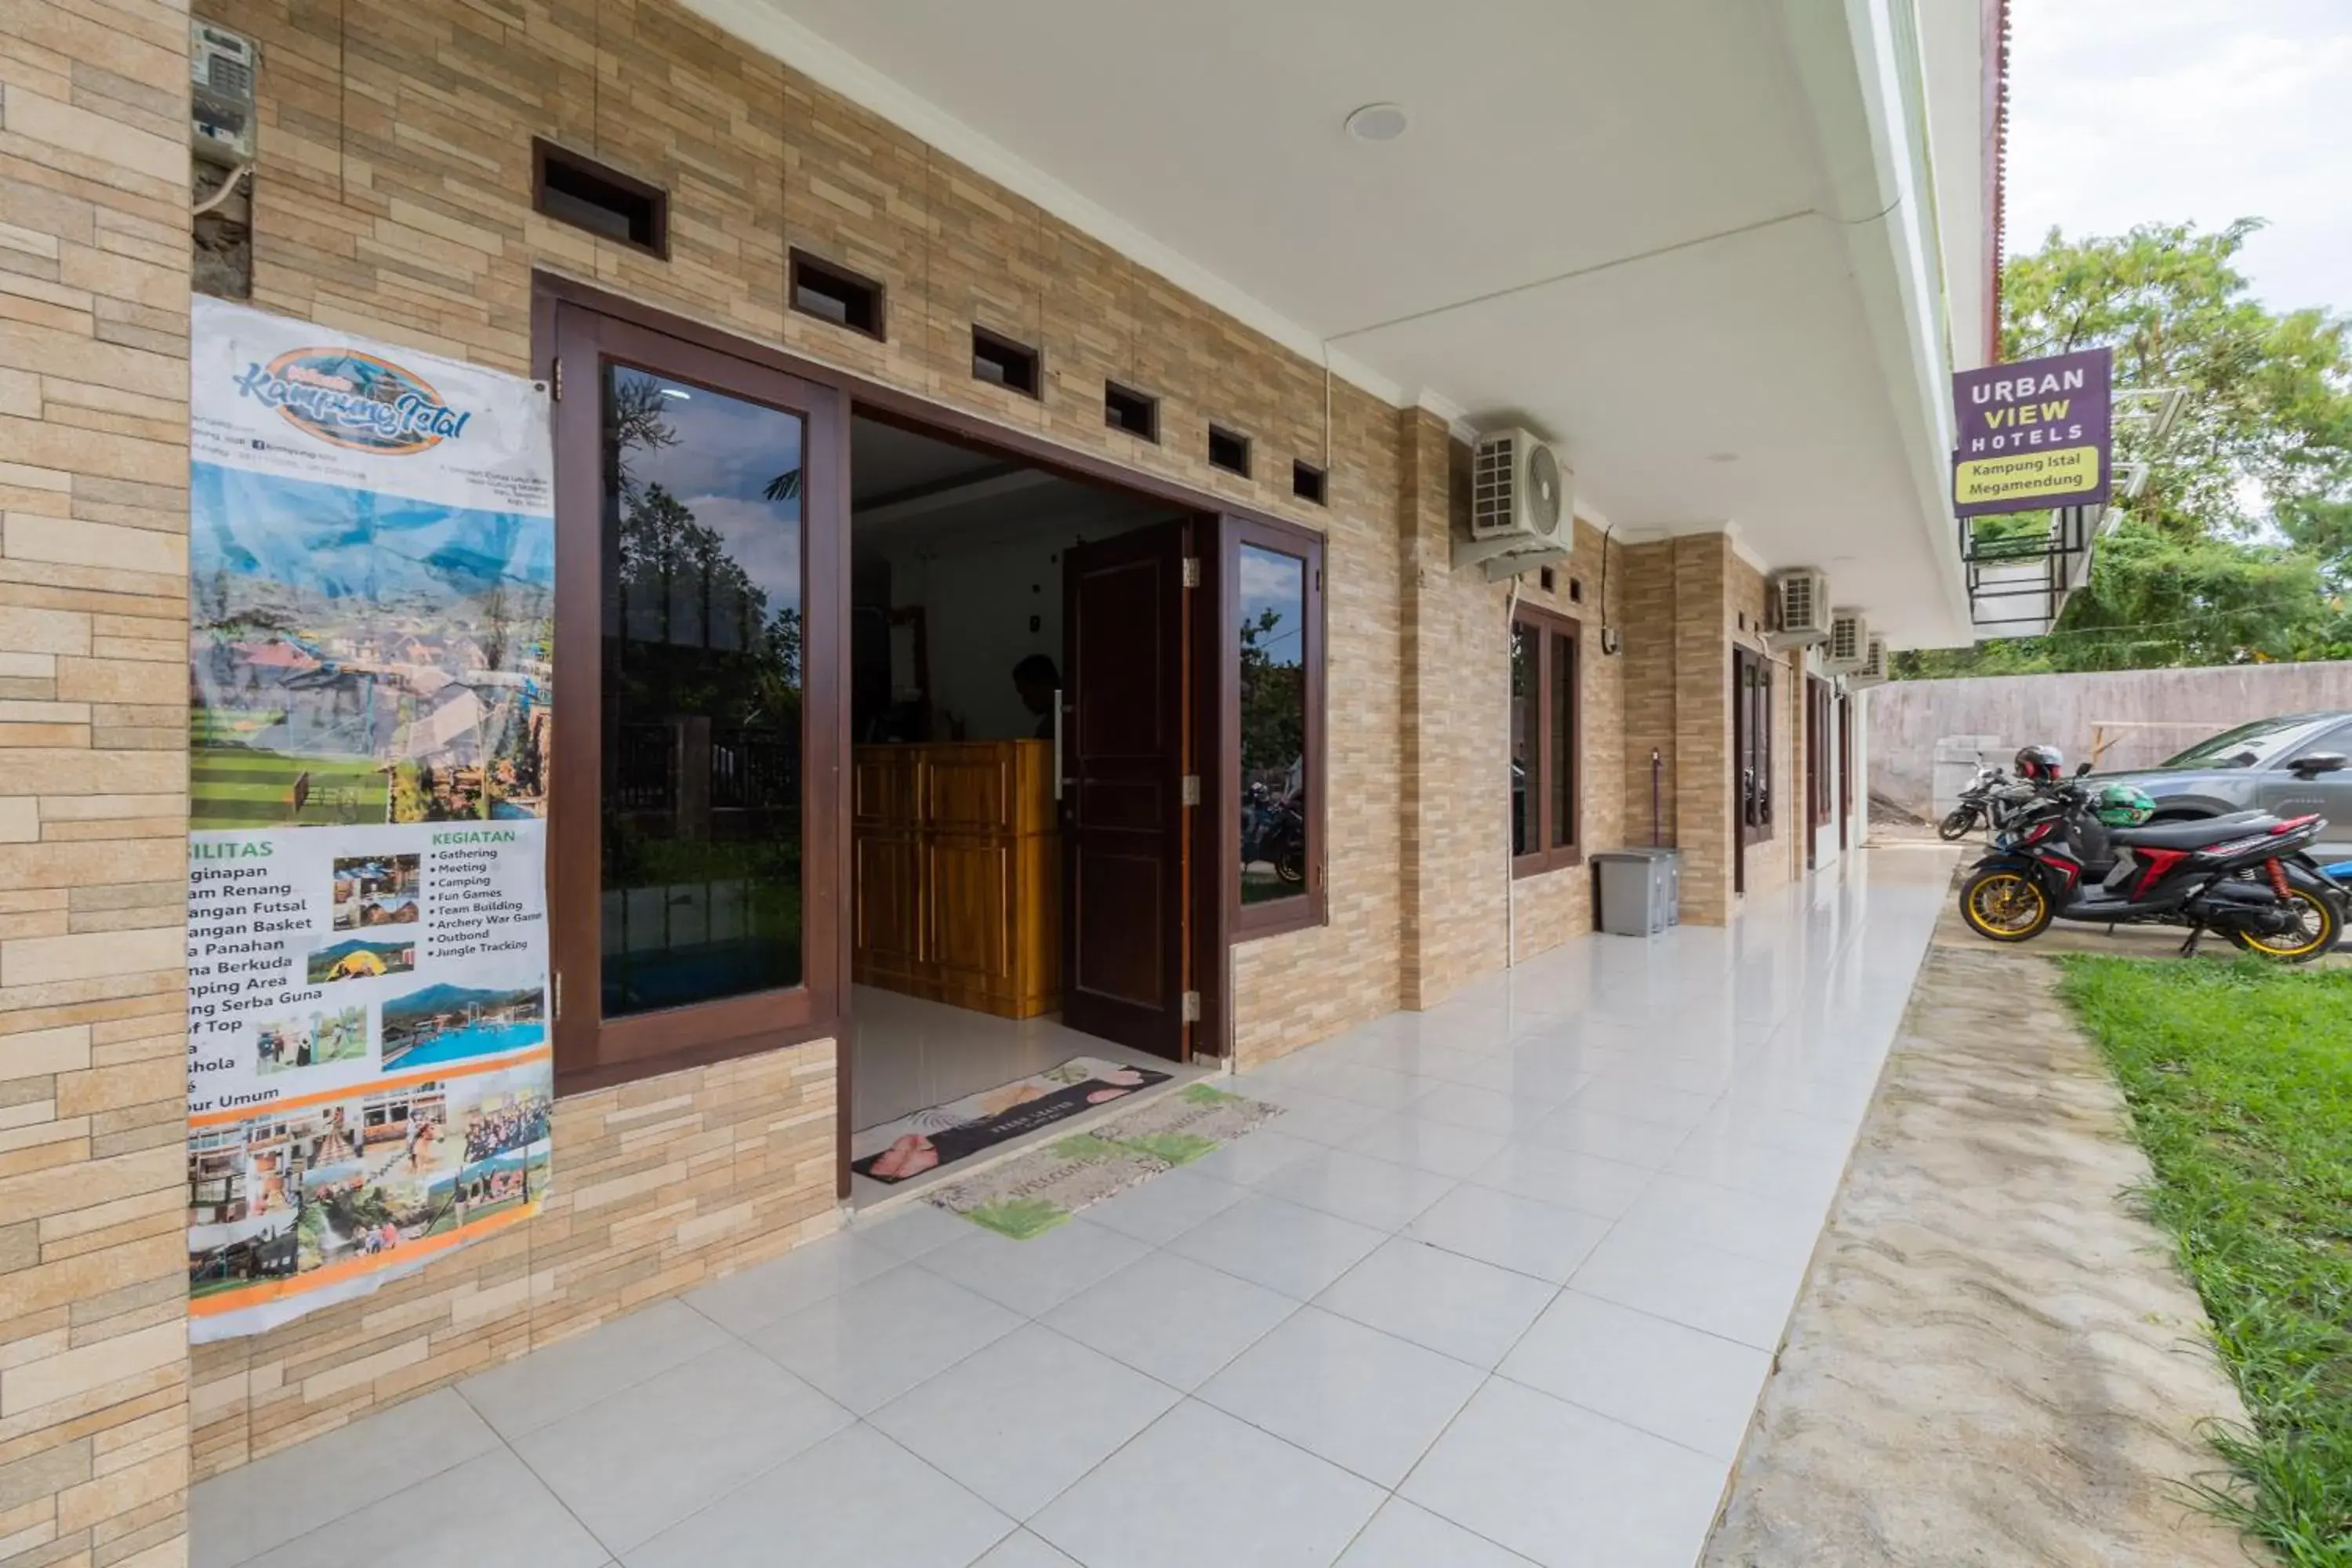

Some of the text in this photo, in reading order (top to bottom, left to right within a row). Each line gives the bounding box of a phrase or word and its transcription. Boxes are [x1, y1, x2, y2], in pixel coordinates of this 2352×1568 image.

[1971, 368, 2084, 404] URBAN
[233, 362, 398, 437] Kampung
[1984, 399, 2071, 430] VIEW
[1972, 425, 2082, 452] HOTELS
[1972, 452, 2081, 477] Kampung Istal
[1969, 472, 2083, 496] Megamendung
[432, 831, 515, 845] KEGIATAN
[188, 840, 274, 859] ILITAS
[438, 848, 498, 860] Gathering
[191, 866, 267, 884] ginapan
[438, 863, 487, 873] Meeting
[438, 877, 491, 887] Camping
[223, 884, 292, 898] Renang
[463, 890, 502, 899] Games
[188, 899, 307, 920] angan Futsal
[438, 901, 524, 915] Team Building
[188, 918, 313, 939] angan Basket
[437, 912, 543, 929] Archery War Game
[437, 929, 490, 943] Outbond
[205, 939, 285, 956] Panahan
[436, 940, 528, 957] Jungle Tracking
[217, 956, 292, 974] Berkuda
[246, 977, 288, 990] Area
[187, 989, 323, 1017] ng Serba Guna
[206, 1020, 243, 1033] Top
[220, 1088, 279, 1108] Umum
